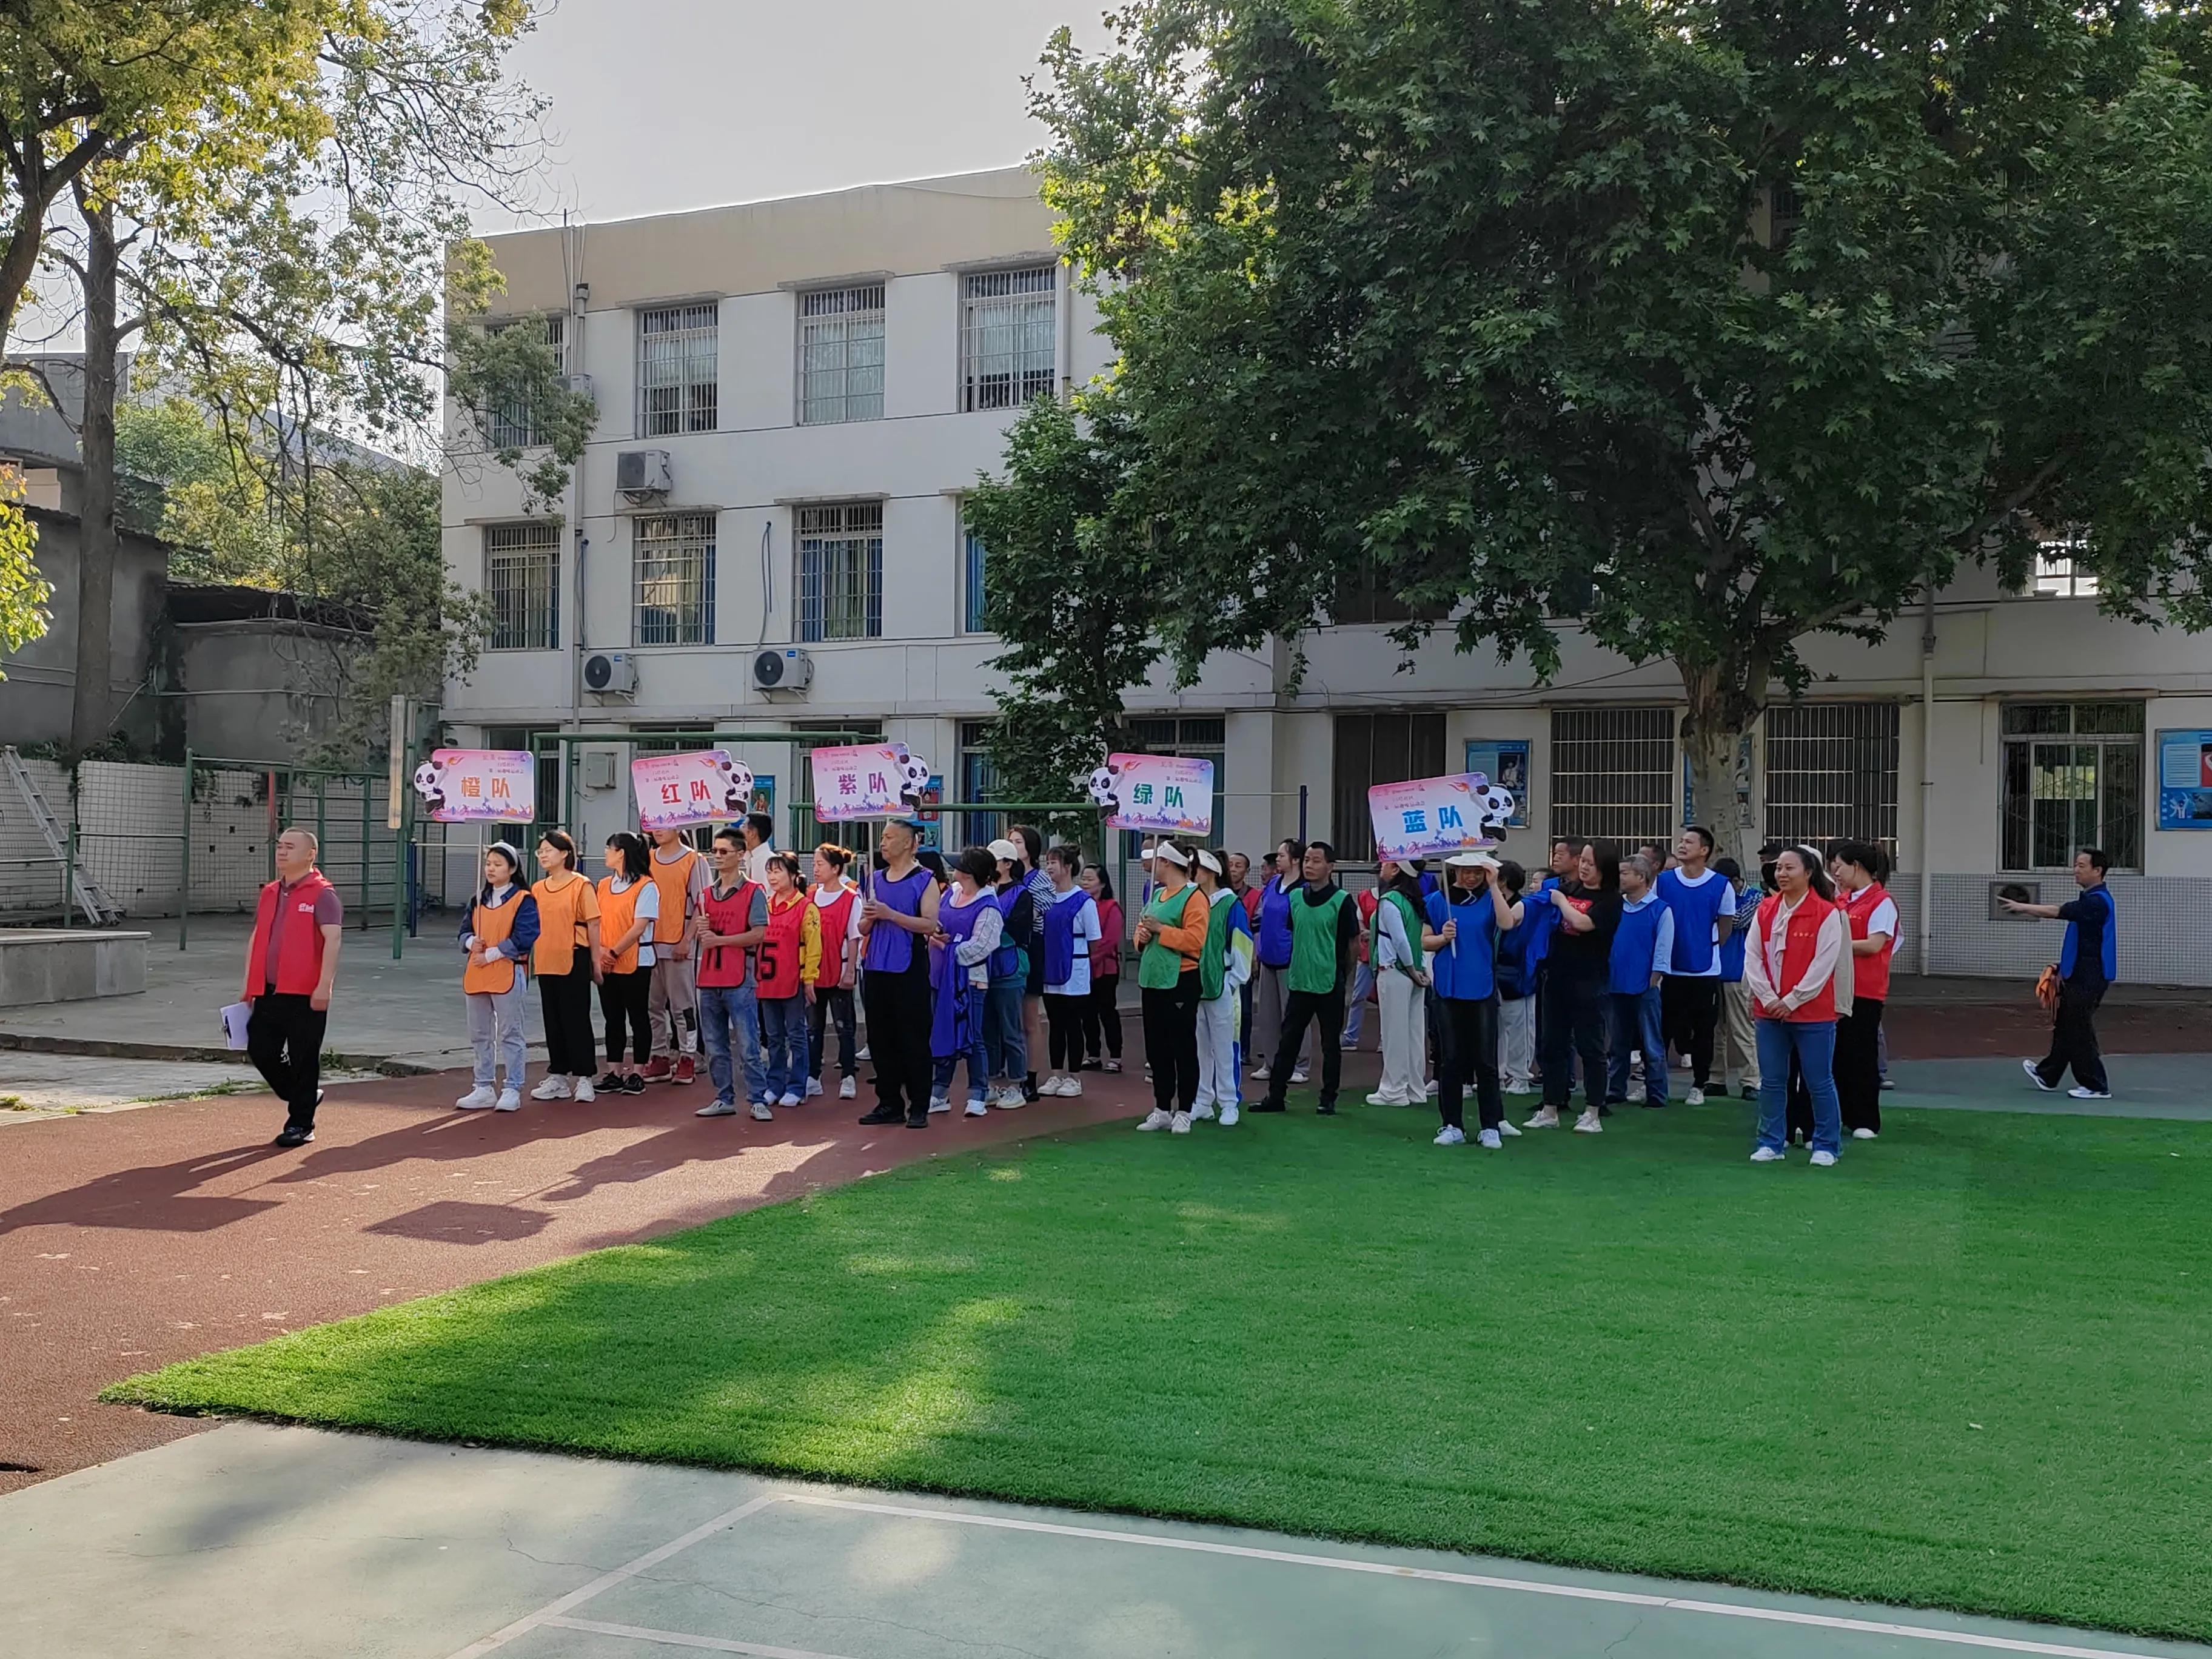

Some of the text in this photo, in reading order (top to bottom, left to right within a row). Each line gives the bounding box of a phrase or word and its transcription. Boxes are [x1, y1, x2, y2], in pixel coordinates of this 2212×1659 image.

[461, 776, 511, 799] 橙队
[661, 779, 711, 804] 红队
[838, 771, 888, 795] 紫队
[1133, 783, 1184, 808] 绿队
[1402, 805, 1463, 834] 蓝队
